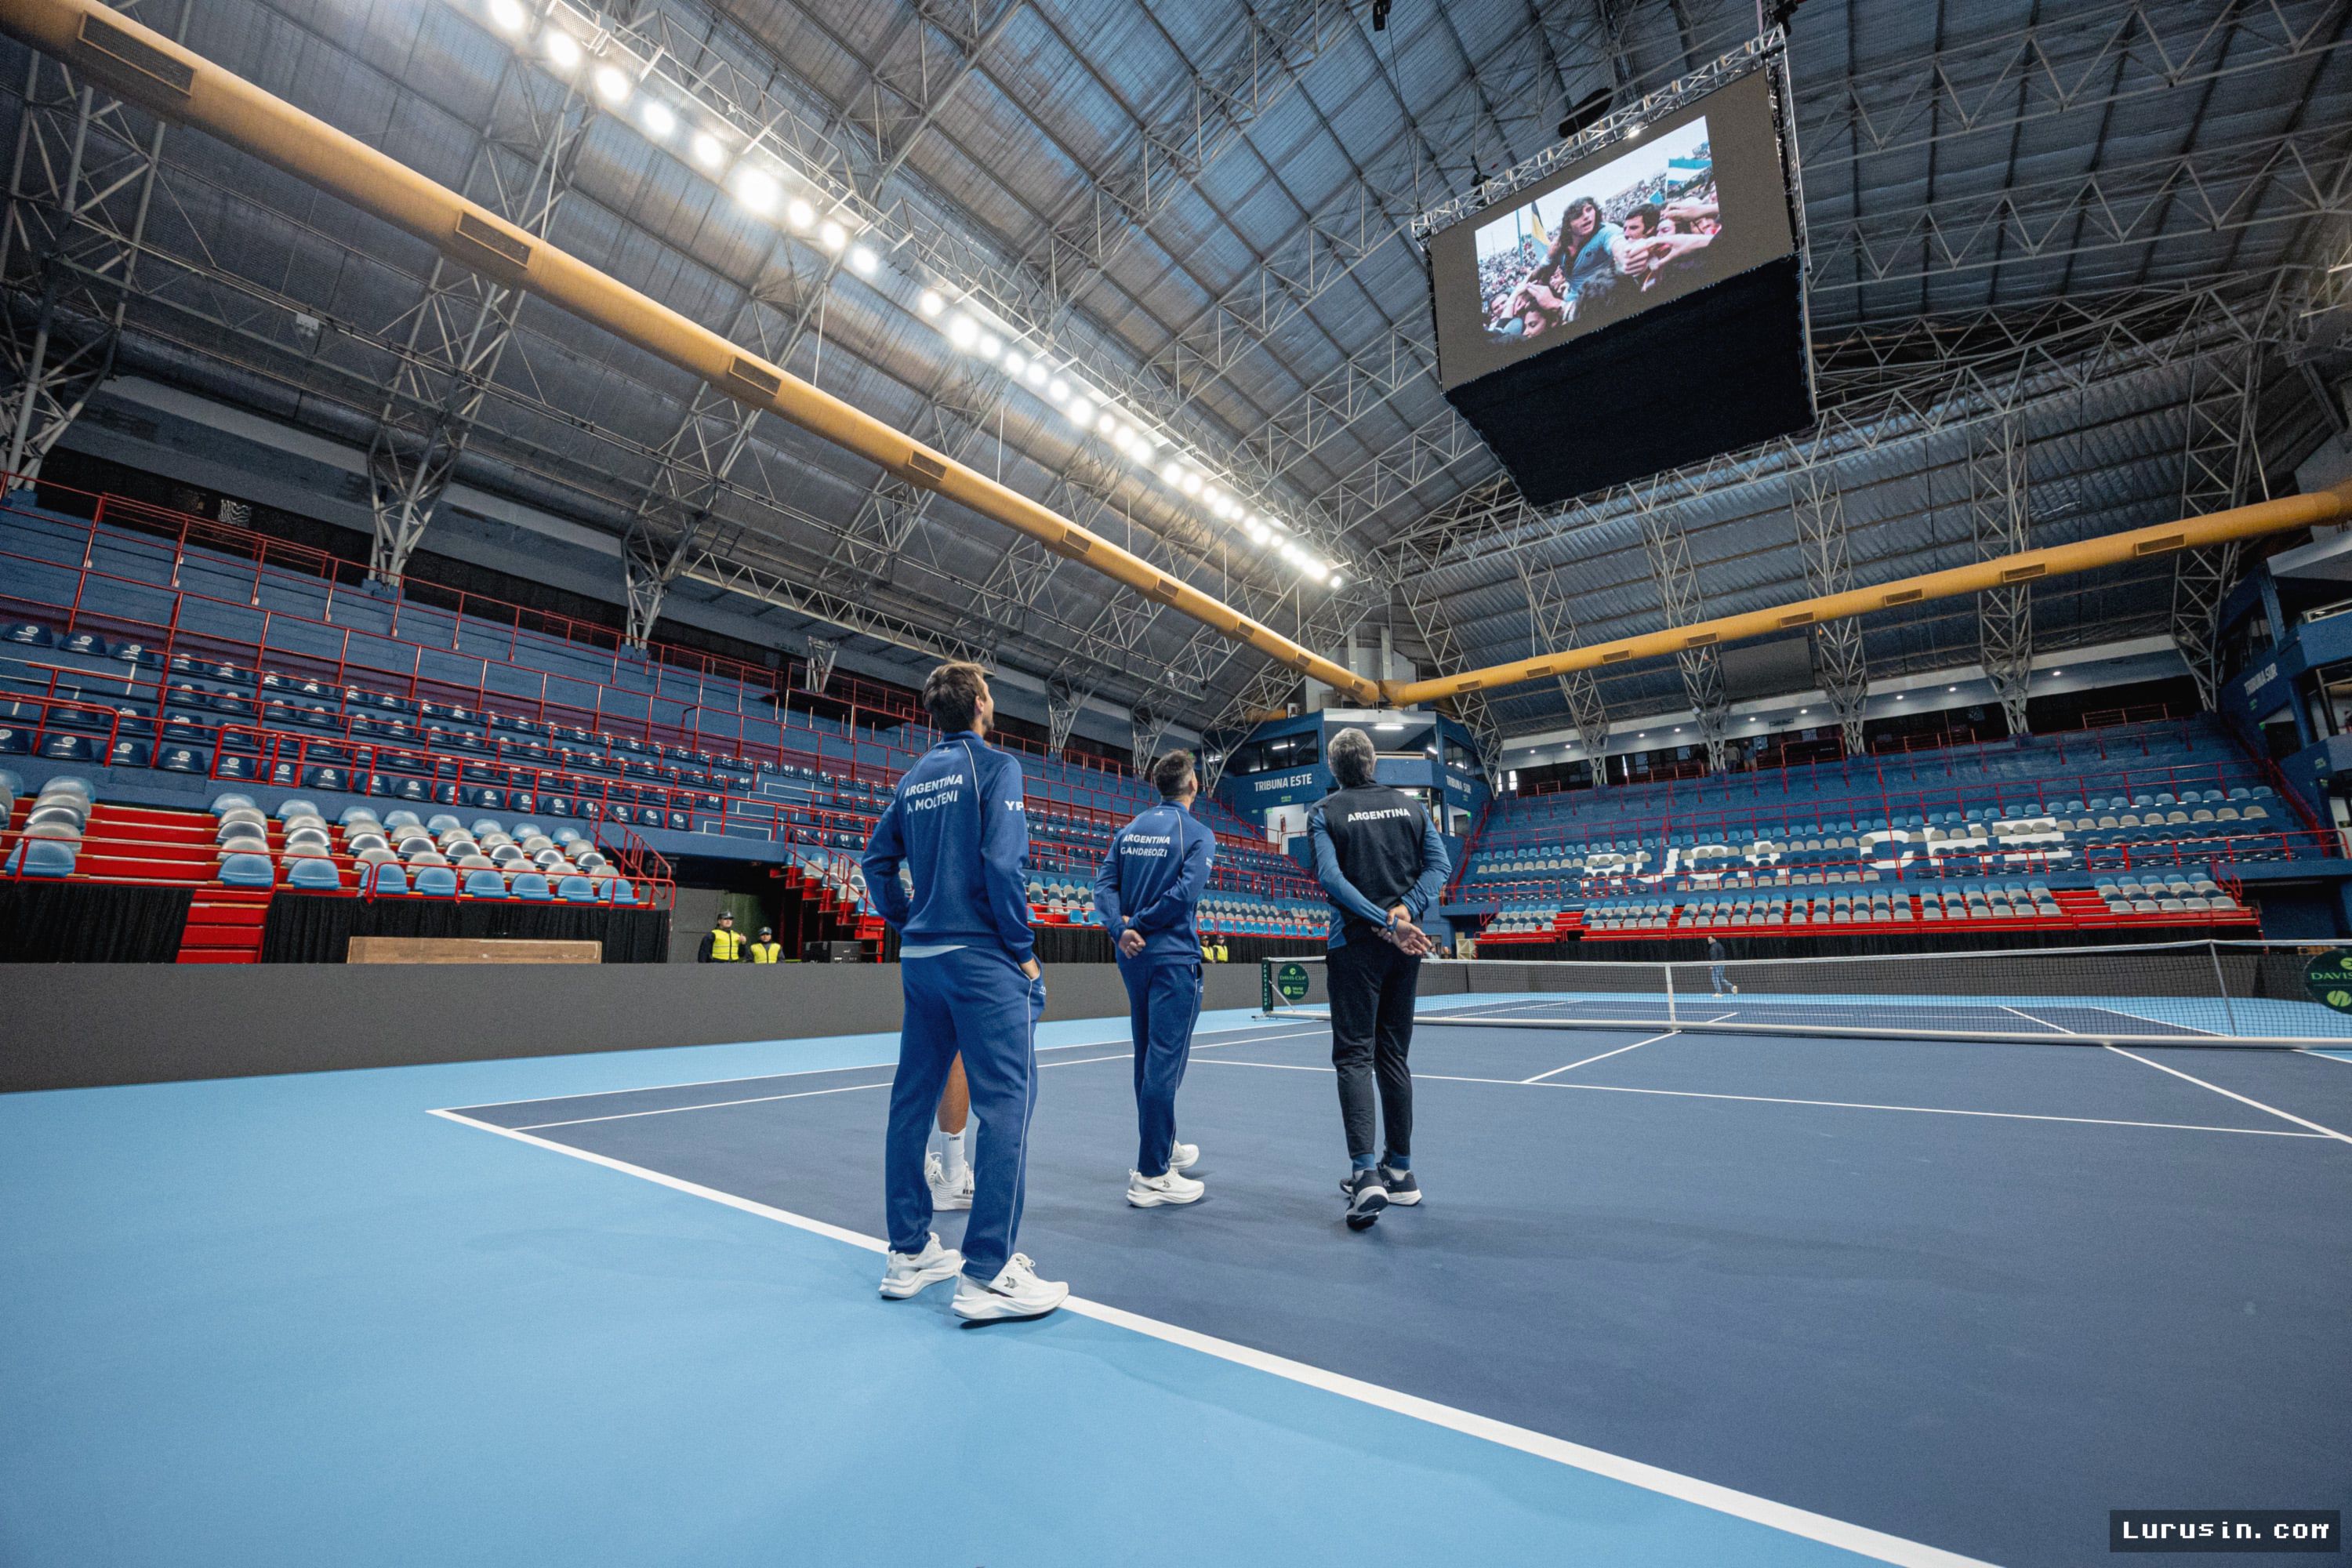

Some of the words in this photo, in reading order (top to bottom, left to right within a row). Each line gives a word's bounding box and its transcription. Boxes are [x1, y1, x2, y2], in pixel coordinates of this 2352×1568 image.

[905, 775, 963, 799] ARGENTINA
[1254, 777, 1289, 792] TRIBUNA
[1290, 773, 1312, 787] ESTE
[906, 802, 913, 815] A
[915, 790, 958, 811] MOLTENI
[1348, 808, 1411, 822] ARGENTINA
[1123, 833, 1171, 844] ARGENTINA
